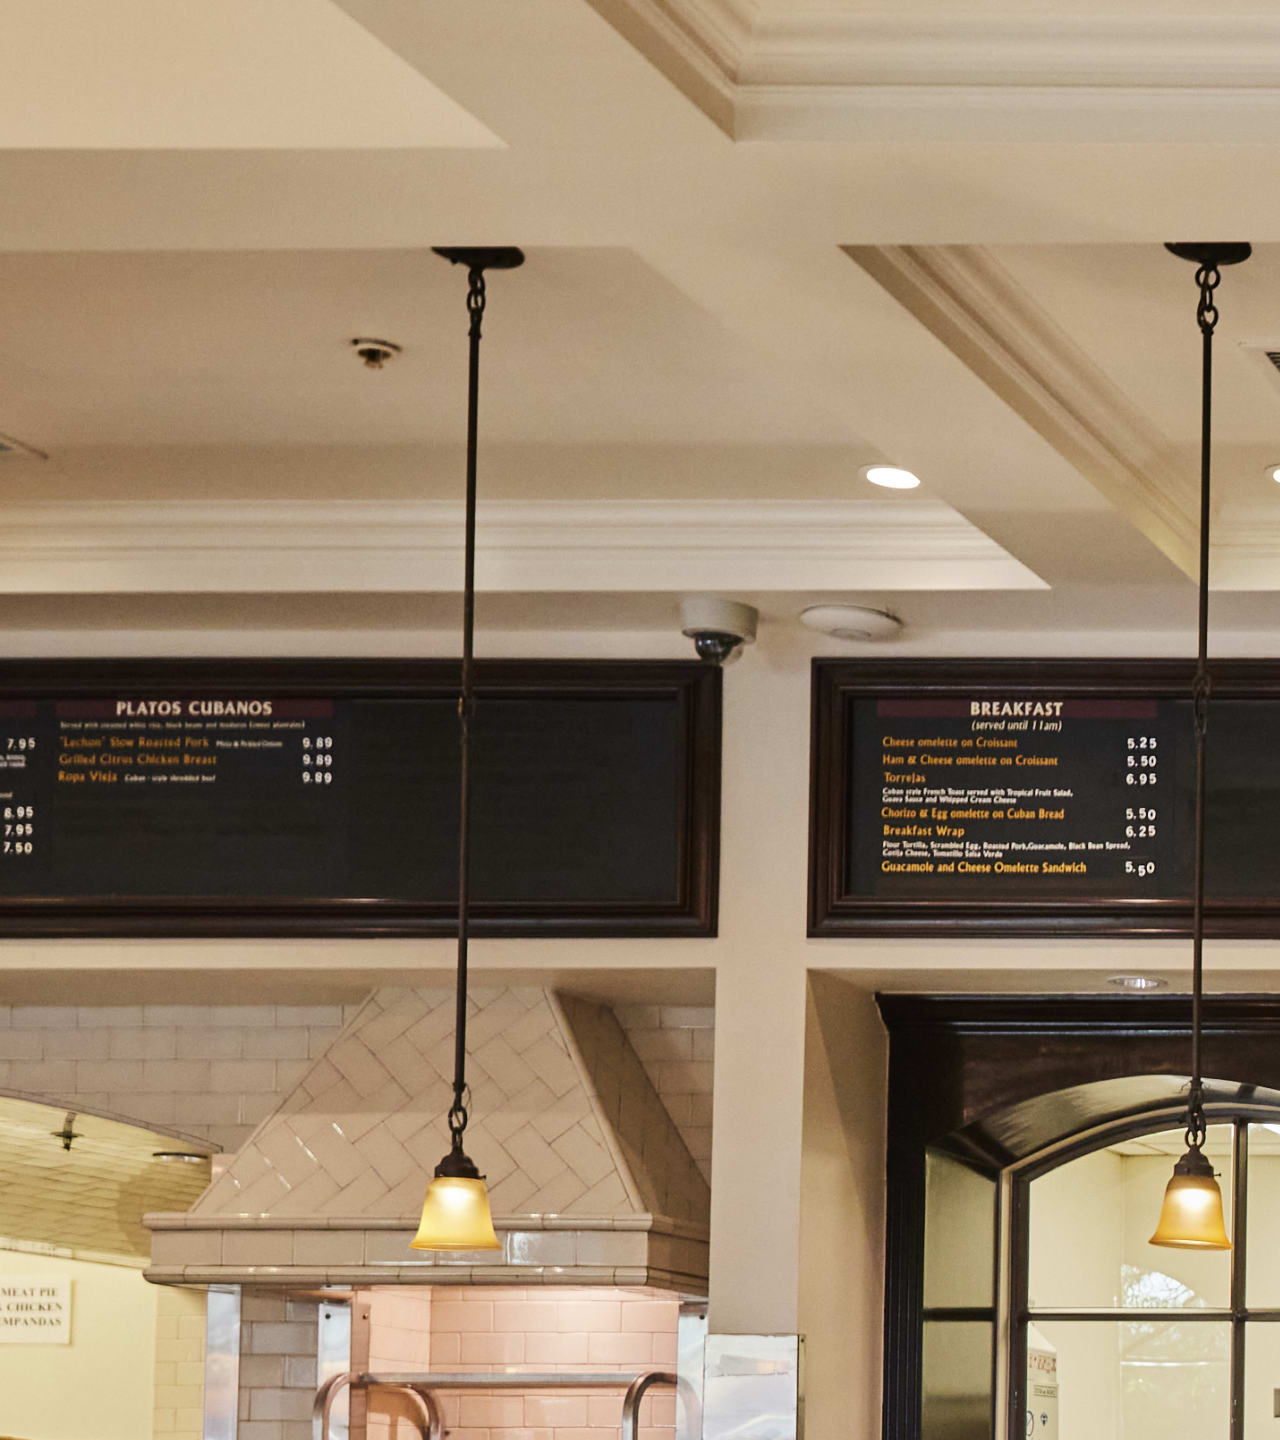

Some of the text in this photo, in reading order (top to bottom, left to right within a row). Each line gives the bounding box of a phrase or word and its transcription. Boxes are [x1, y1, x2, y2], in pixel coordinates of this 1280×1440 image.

[116, 700, 272, 716] PLATOS CUBANOS
[970, 701, 1063, 716] BREAKFAST
[971, 720, 1006, 732] (served
[1007, 720, 1029, 731] until
[8, 737, 36, 750] 7.95
[110, 736, 134, 747] Slow
[138, 736, 181, 748] Roasted
[185, 736, 209, 747] Pork
[302, 737, 332, 749] 9.89
[882, 736, 1157, 749] Cheese omelette on Croissant 5.25
[59, 754, 332, 767] Grilled Citrus Chicken Breast 9.89
[882, 754, 1157, 767] Ham & Cheese omelette on Croissant 5.50
[58, 770, 85, 783] Ropa
[89, 771, 117, 783] Vieja
[884, 772, 1157, 785] Torrejas 6.95
[881, 807, 1156, 821] Chorizo & Egg omelette on Cuban Bread 5.50
[5, 823, 33, 836] 7.95
[883, 824, 1156, 838] Breakfast Wrap 6.25
[4, 841, 33, 854] 7.50
[881, 860, 1155, 877] Guacamole and Cheese Omelette Sandwich 5.50
[1, 1288, 56, 1297] MEAT PIE
[6, 1302, 63, 1312] CHICKEN
